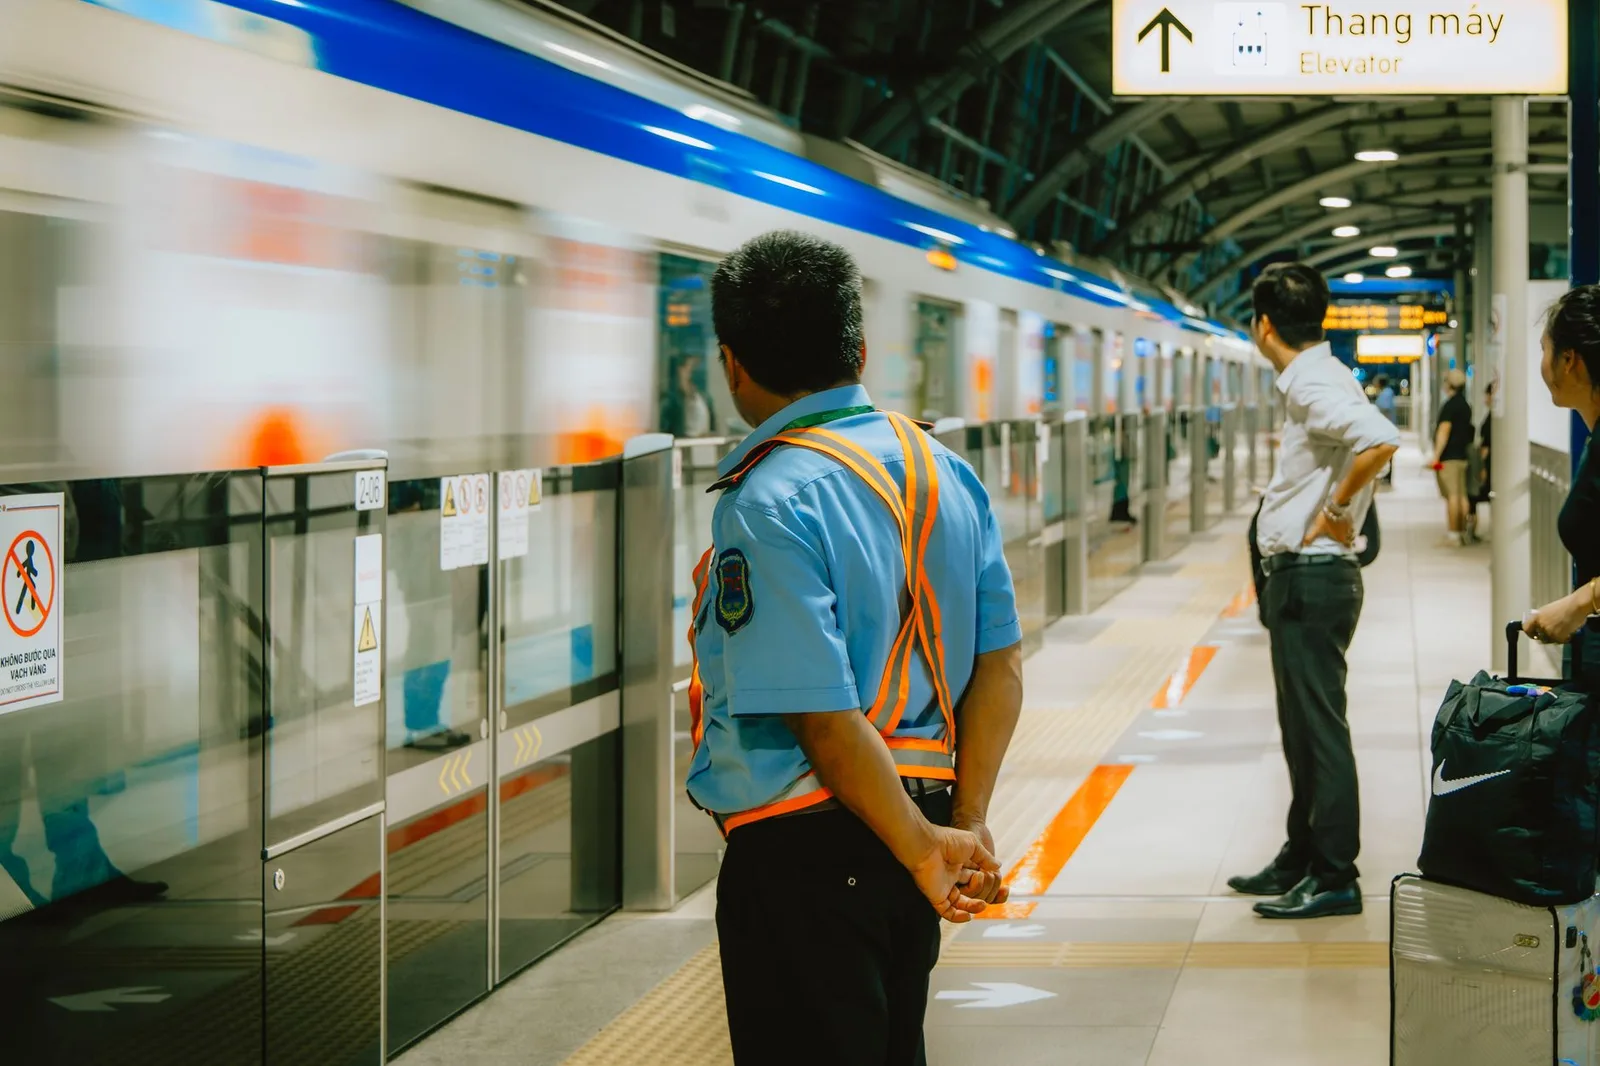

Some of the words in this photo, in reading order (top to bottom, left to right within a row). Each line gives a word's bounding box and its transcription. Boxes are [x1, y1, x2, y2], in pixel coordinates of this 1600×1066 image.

[1301, 5, 1412, 44] Thang
[1429, 4, 1504, 44] máy
[1300, 52, 1403, 74] Elevator
[359, 476, 380, 504] 2-06
[0, 653, 23, 668] KHÔNG
[24, 648, 42, 663] BƯỚC
[43, 648, 56, 661] QUA
[10, 667, 28, 682] VẠCH
[29, 663, 47, 676] VÀNG
